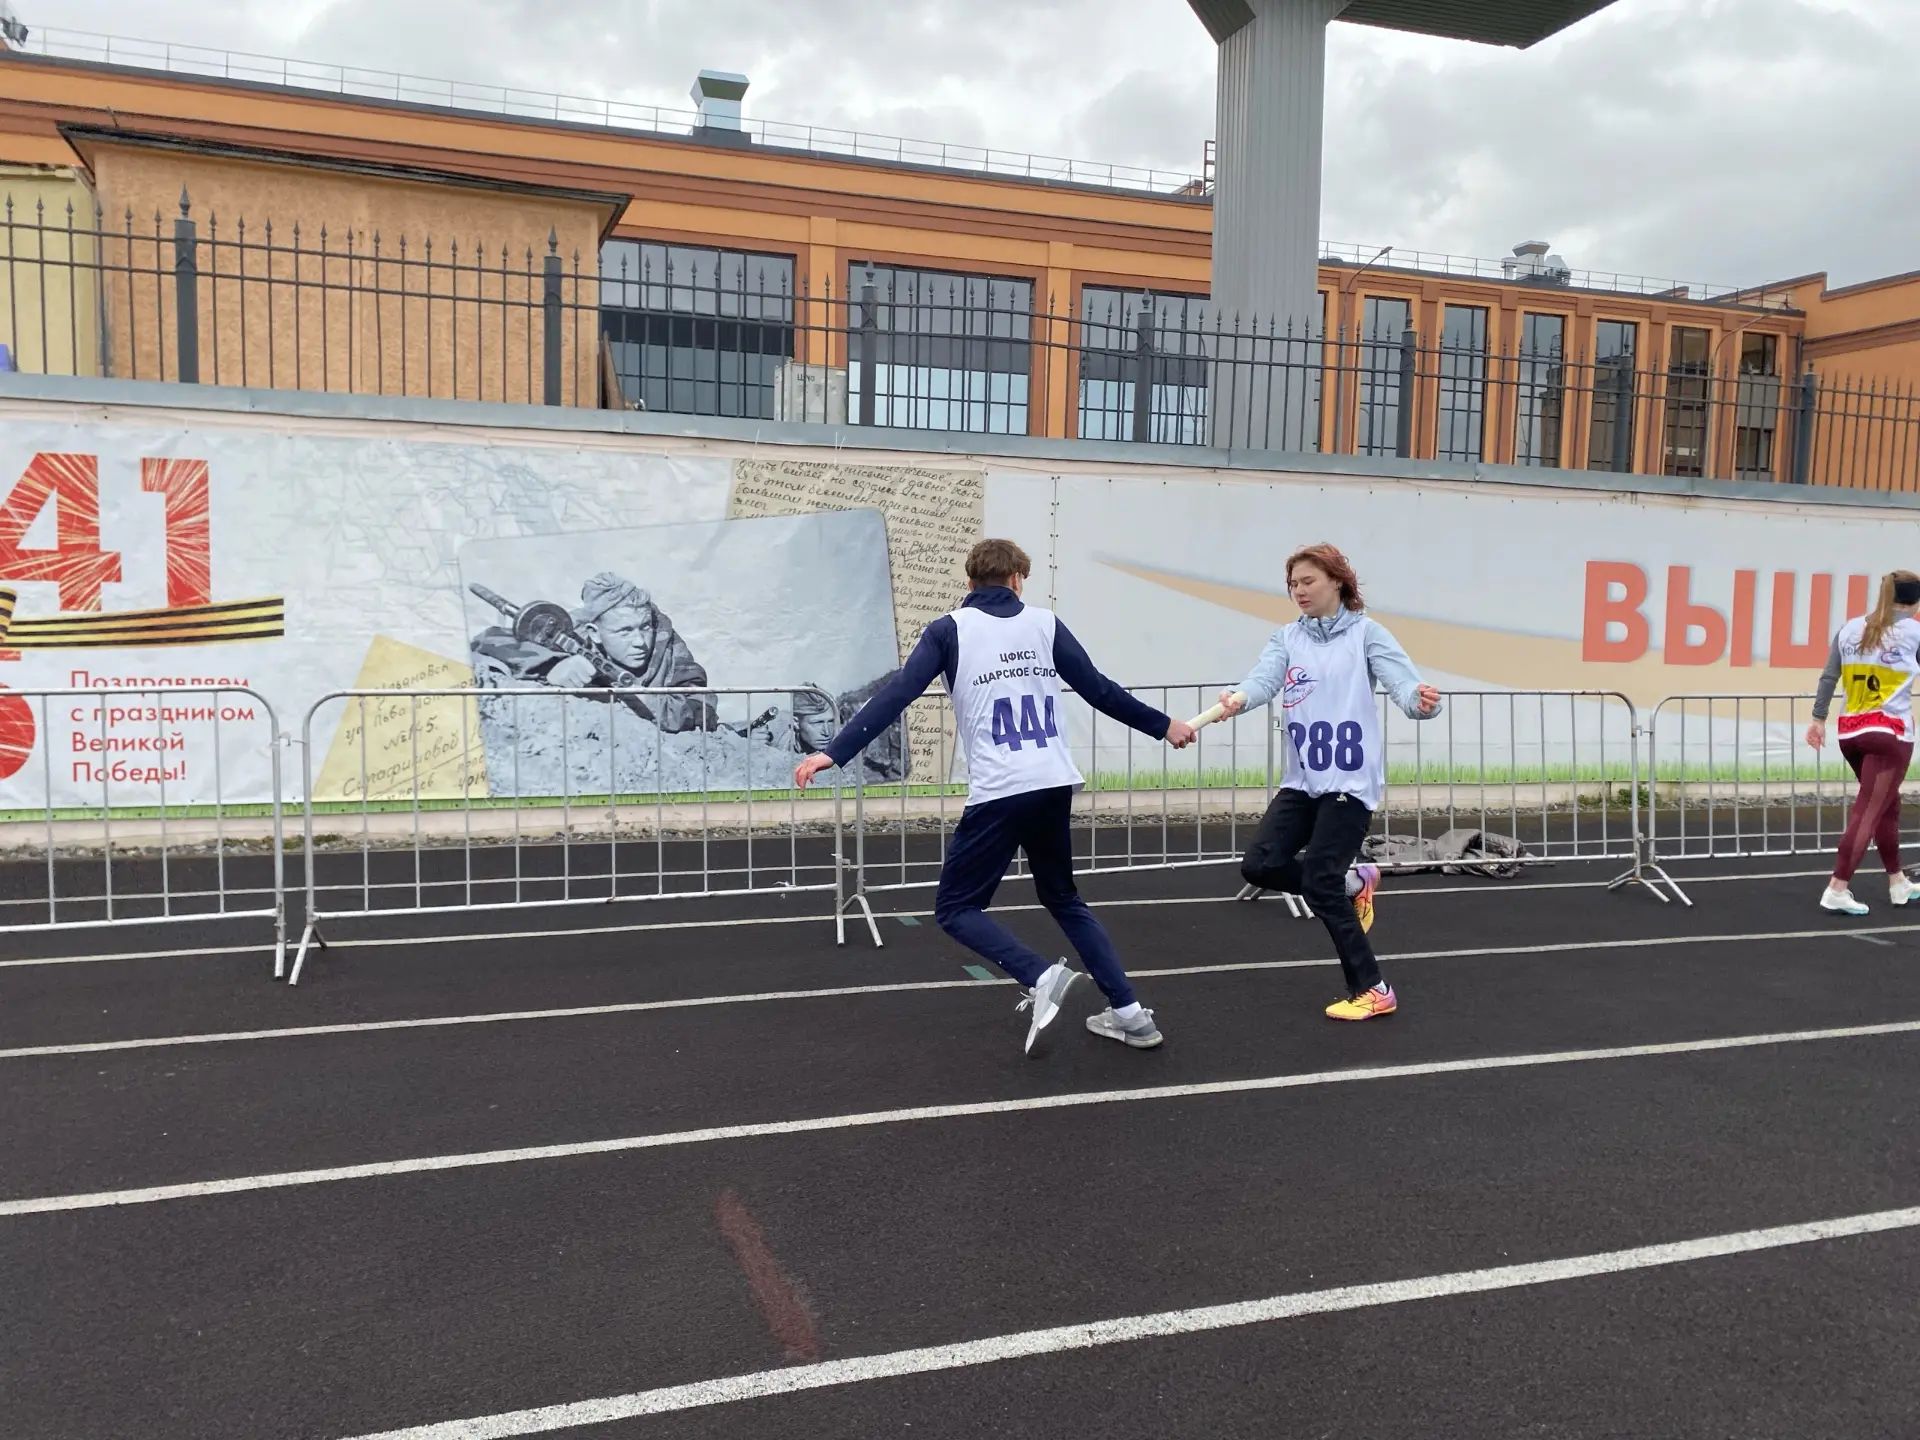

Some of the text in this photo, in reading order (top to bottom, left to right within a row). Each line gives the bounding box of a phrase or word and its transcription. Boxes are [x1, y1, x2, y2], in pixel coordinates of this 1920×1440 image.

[1582, 561, 1920, 668] ВЫШ
[71, 708, 255, 727] с праздником
[72, 732, 185, 752] Великой
[1287, 721, 1364, 771] 288
[73, 761, 187, 784] Победы!
